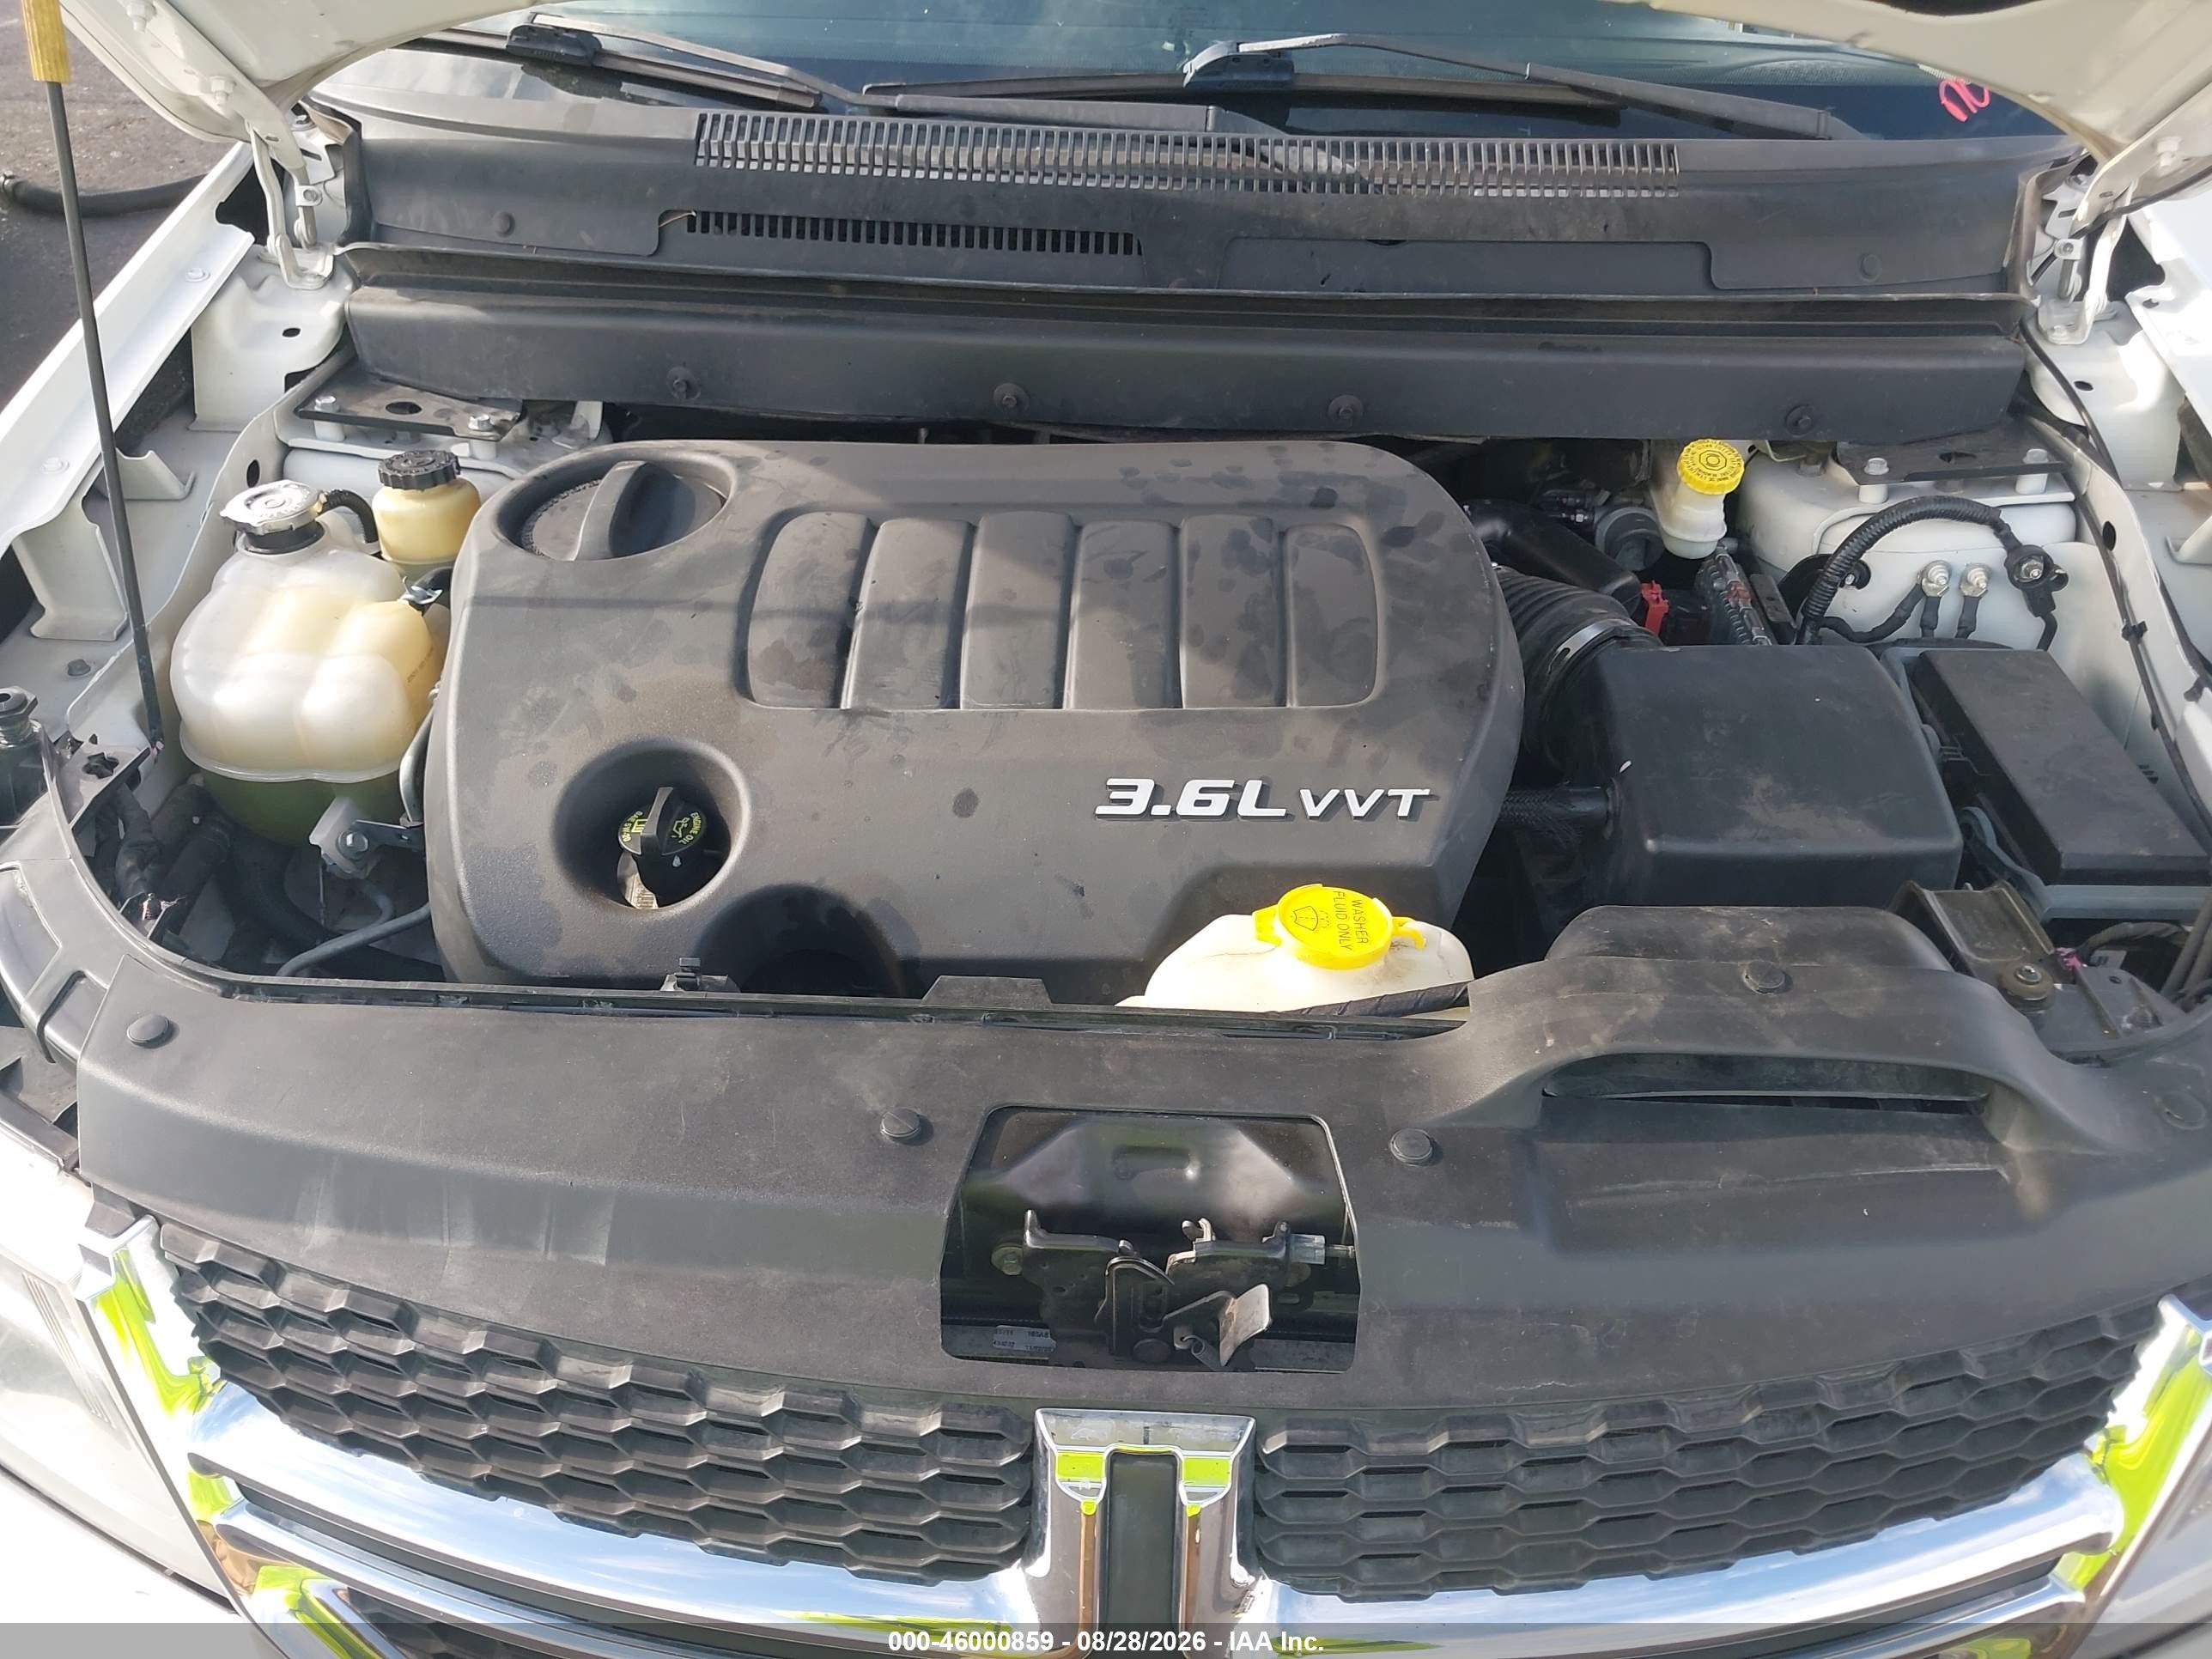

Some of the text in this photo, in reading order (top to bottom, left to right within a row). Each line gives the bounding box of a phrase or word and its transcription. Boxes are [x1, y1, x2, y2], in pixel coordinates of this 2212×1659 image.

[1095, 778, 1431, 818] 3.6L VVT
[678, 812, 702, 844] ENGINE OIL
[1332, 890, 1352, 951] FLUID ONLY
[1351, 899, 1369, 944] WASHER
